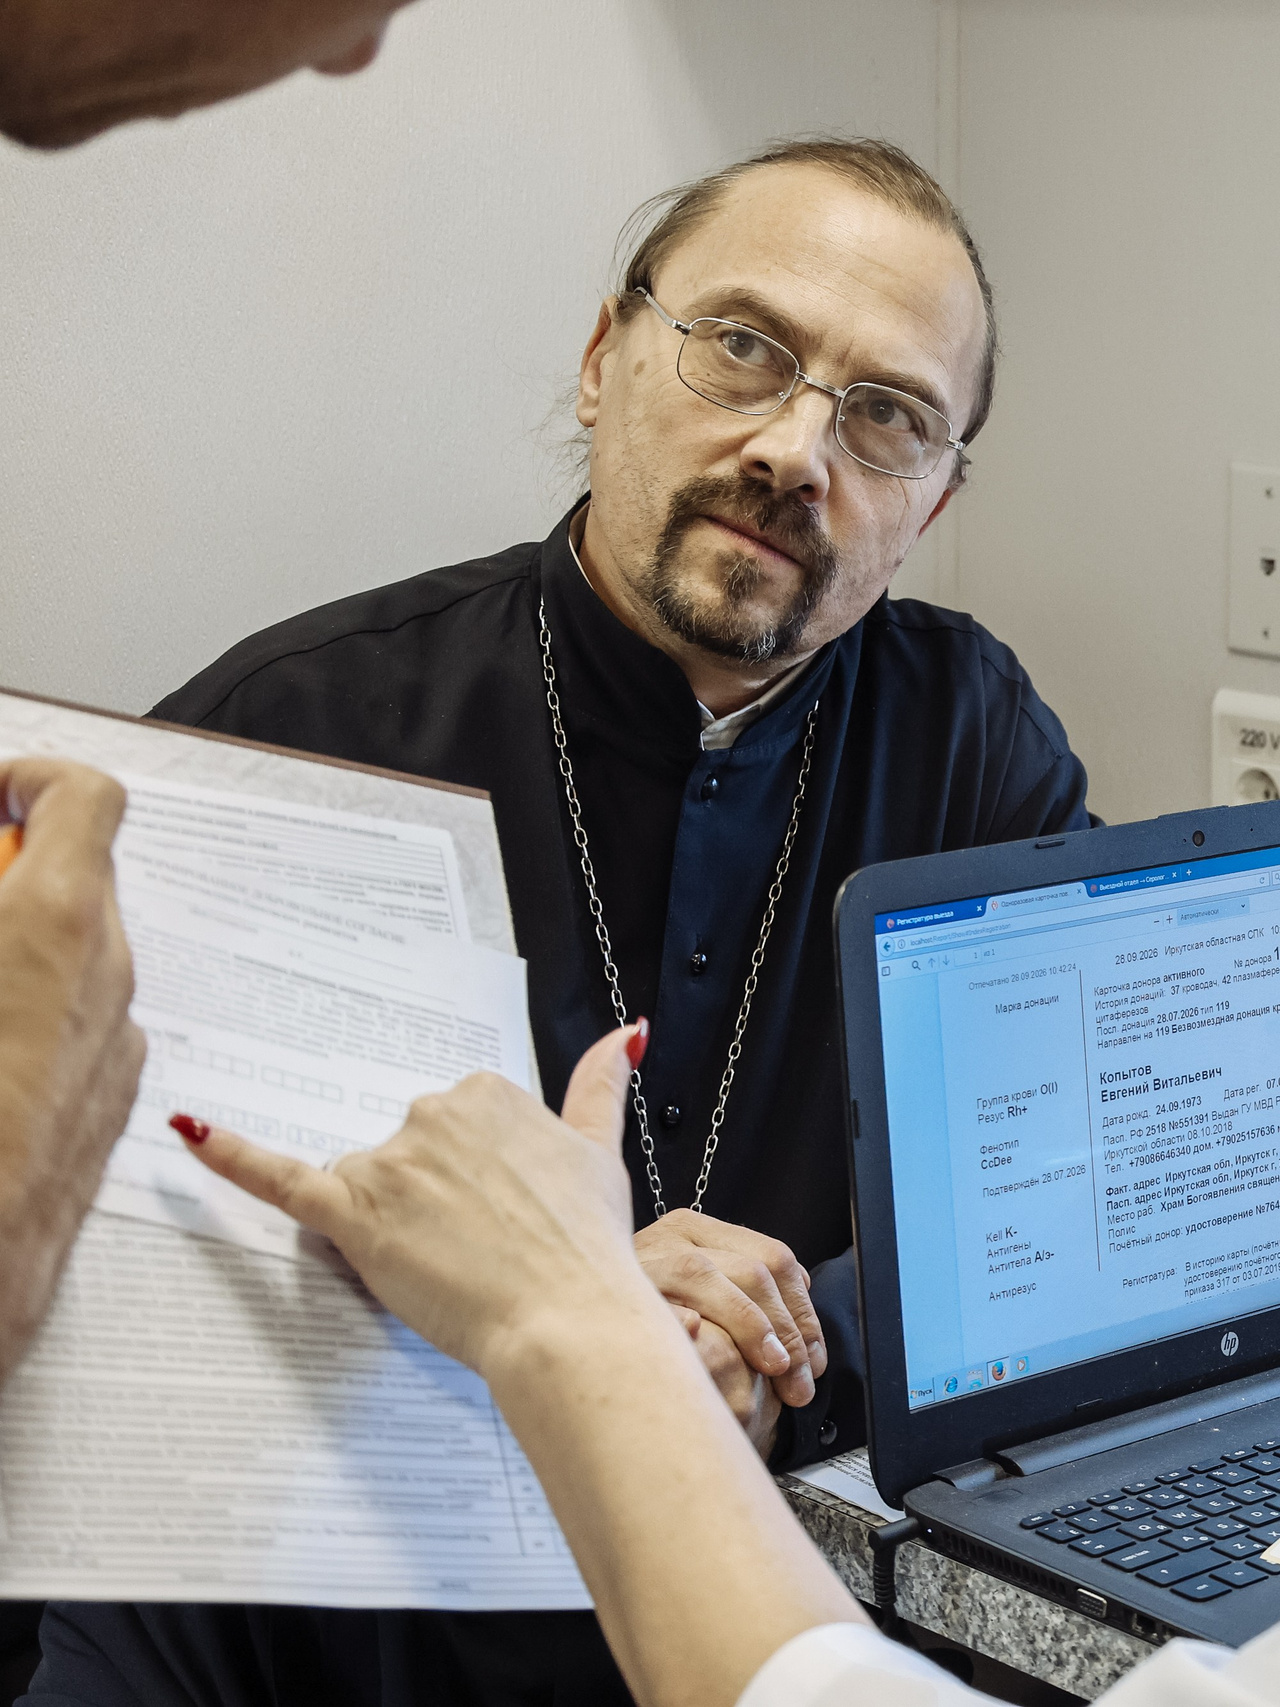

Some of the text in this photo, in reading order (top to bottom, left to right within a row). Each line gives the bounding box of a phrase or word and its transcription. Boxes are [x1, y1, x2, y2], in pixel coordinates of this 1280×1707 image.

[1240, 728, 1267, 749] 220
[1114, 947, 1159, 966] 28.09.2026
[1164, 941, 1204, 957] Иркутская
[1205, 933, 1246, 948] областная
[1247, 927, 1265, 940] СПК
[1244, 954, 1272, 969] донора
[1093, 967, 1205, 997] Карточка донора активного
[1094, 997, 1129, 1011] История
[1170, 984, 1180, 996] 37
[1221, 974, 1232, 985] 42
[995, 994, 1059, 1014] Марка донации
[1095, 1006, 1149, 1026] цитаферезов
[1097, 1034, 1142, 1050] Направлен
[1143, 1031, 1154, 1040] на
[1155, 1025, 1170, 1037] 119
[1171, 1013, 1235, 1034] Безвозмездная
[1235, 1005, 1271, 1022] донация
[1121, 1017, 1155, 1034] донация
[1156, 1006, 1199, 1025] 28.07.2026
[1200, 1005, 1214, 1015] тип
[1215, 1000, 1230, 1012] 119
[1099, 1065, 1152, 1085] Копытов
[1101, 1066, 1222, 1103] Евгений Витальевич
[976, 1094, 1010, 1111] Группа
[1011, 1088, 1038, 1103] крови
[1223, 1087, 1244, 1102] Дата
[977, 1105, 1028, 1125] Резус Rh+
[1102, 1115, 1124, 1130] Дата
[1155, 1095, 1202, 1116] 24.09.1973
[1102, 1134, 1128, 1146] Пасп.
[1129, 1128, 1144, 1140] РФ
[1145, 1122, 1167, 1137] 2518
[1211, 1107, 1239, 1122] Выдан
[1241, 1102, 1252, 1114] ГУ
[1253, 1097, 1274, 1111] МВД
[979, 1139, 1020, 1155] Фенотип
[1103, 1120, 1233, 1162] Иркутской области 08.10.2018
[980, 1155, 1012, 1170] CcDee
[1104, 1163, 1124, 1174] Тел.
[1192, 1141, 1214, 1155] дом.
[982, 1164, 1087, 1198] Подтверждён 28.07.2026
[1105, 1184, 1131, 1197] Факт.
[1133, 1176, 1161, 1192] адрес
[1165, 1164, 1212, 1184] Иркутская
[1234, 1149, 1271, 1166] Иркутск
[1106, 1198, 1132, 1212] Пасп.
[1134, 1190, 1163, 1205] адрес
[1163, 1178, 1210, 1198] Иркутская
[1233, 1163, 1270, 1180] Иркутск
[1107, 1211, 1136, 1226] Место
[1160, 1198, 1185, 1213] Храм
[1186, 1183, 1246, 1206] Богоявления
[986, 1230, 1003, 1244] Kell
[1108, 1225, 1136, 1240] Полис
[1109, 1233, 1153, 1254] Почётный
[1185, 1208, 1254, 1236] удостоверение
[986, 1240, 1032, 1259] Антигены
[988, 1256, 1032, 1274] Антитела
[1122, 1267, 1178, 1289] Регистратура:
[988, 1282, 1037, 1302] Антирезус
[1223, 1332, 1237, 1356] hp
